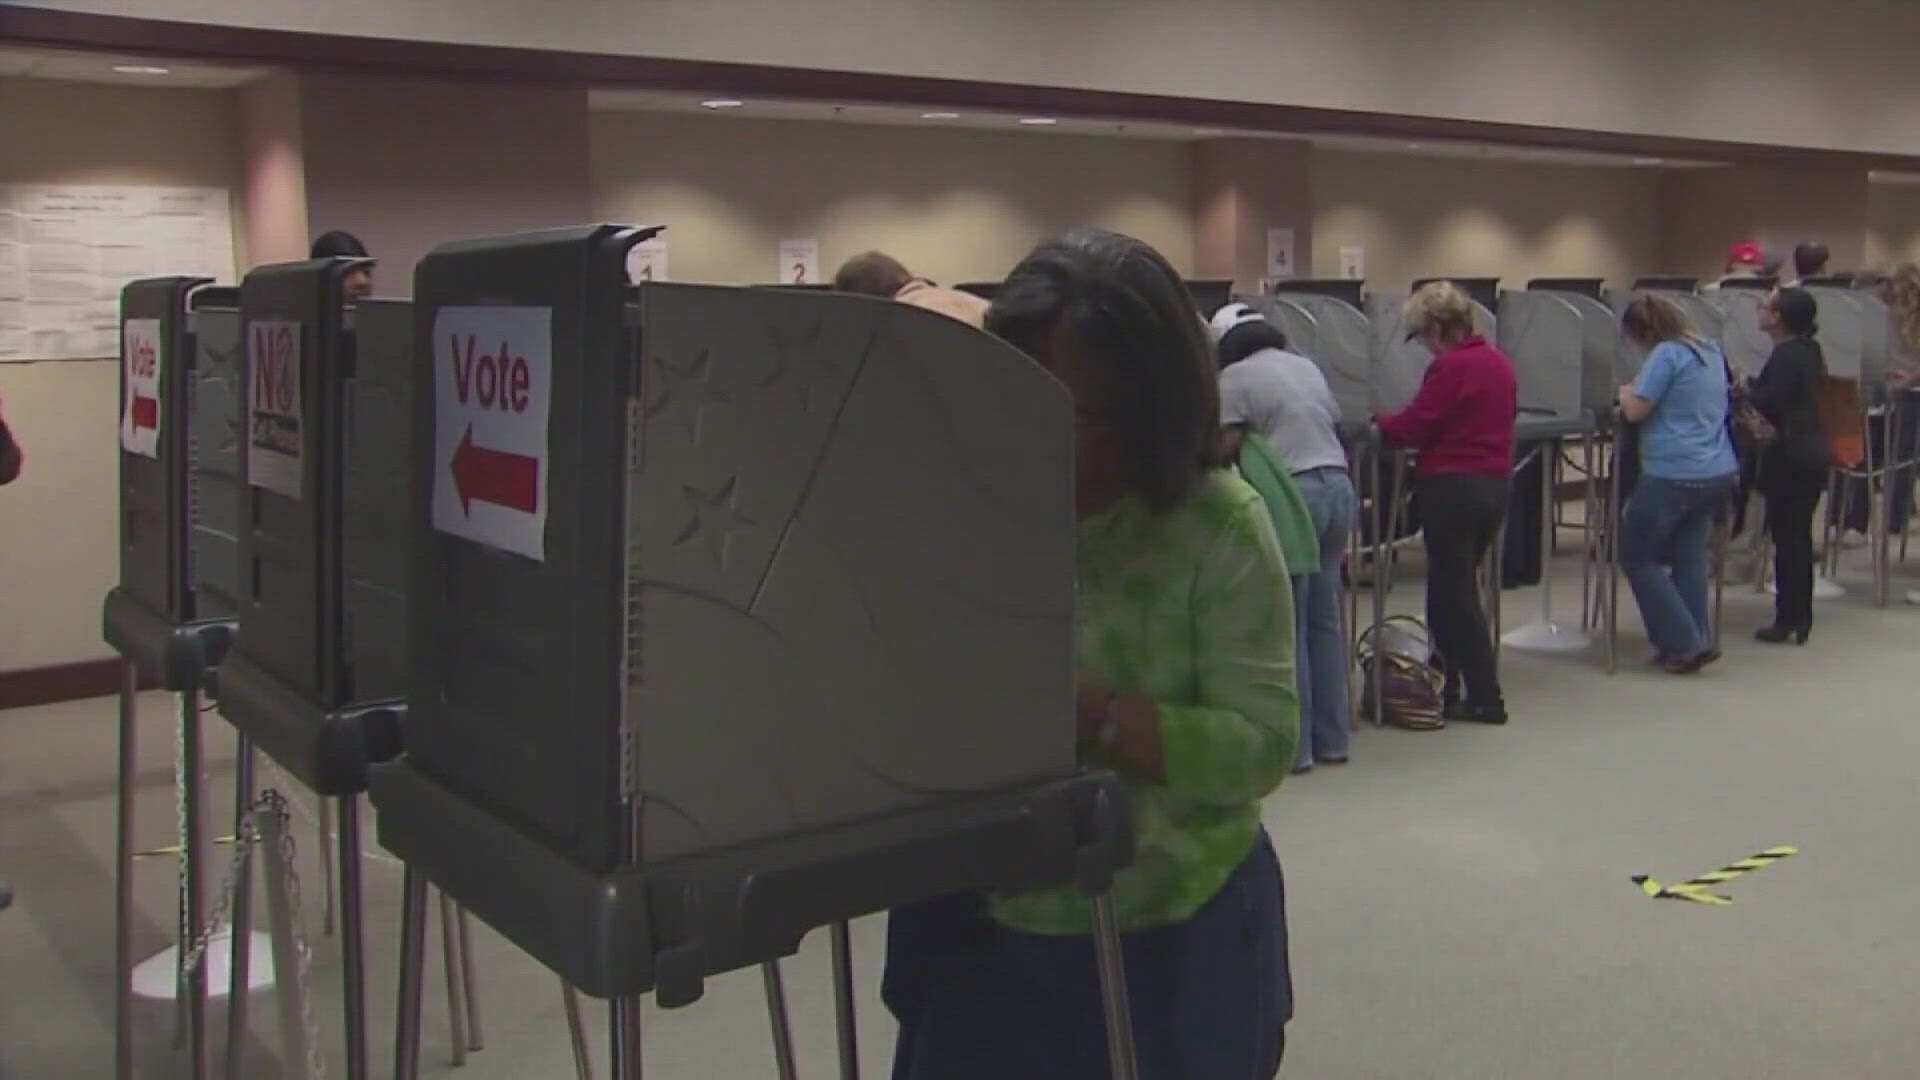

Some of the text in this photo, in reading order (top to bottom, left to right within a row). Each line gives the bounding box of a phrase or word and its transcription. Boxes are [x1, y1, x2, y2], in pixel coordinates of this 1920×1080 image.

[793, 263, 806, 284] 2
[130, 333, 156, 379] Vote
[451, 333, 529, 413] Vote
